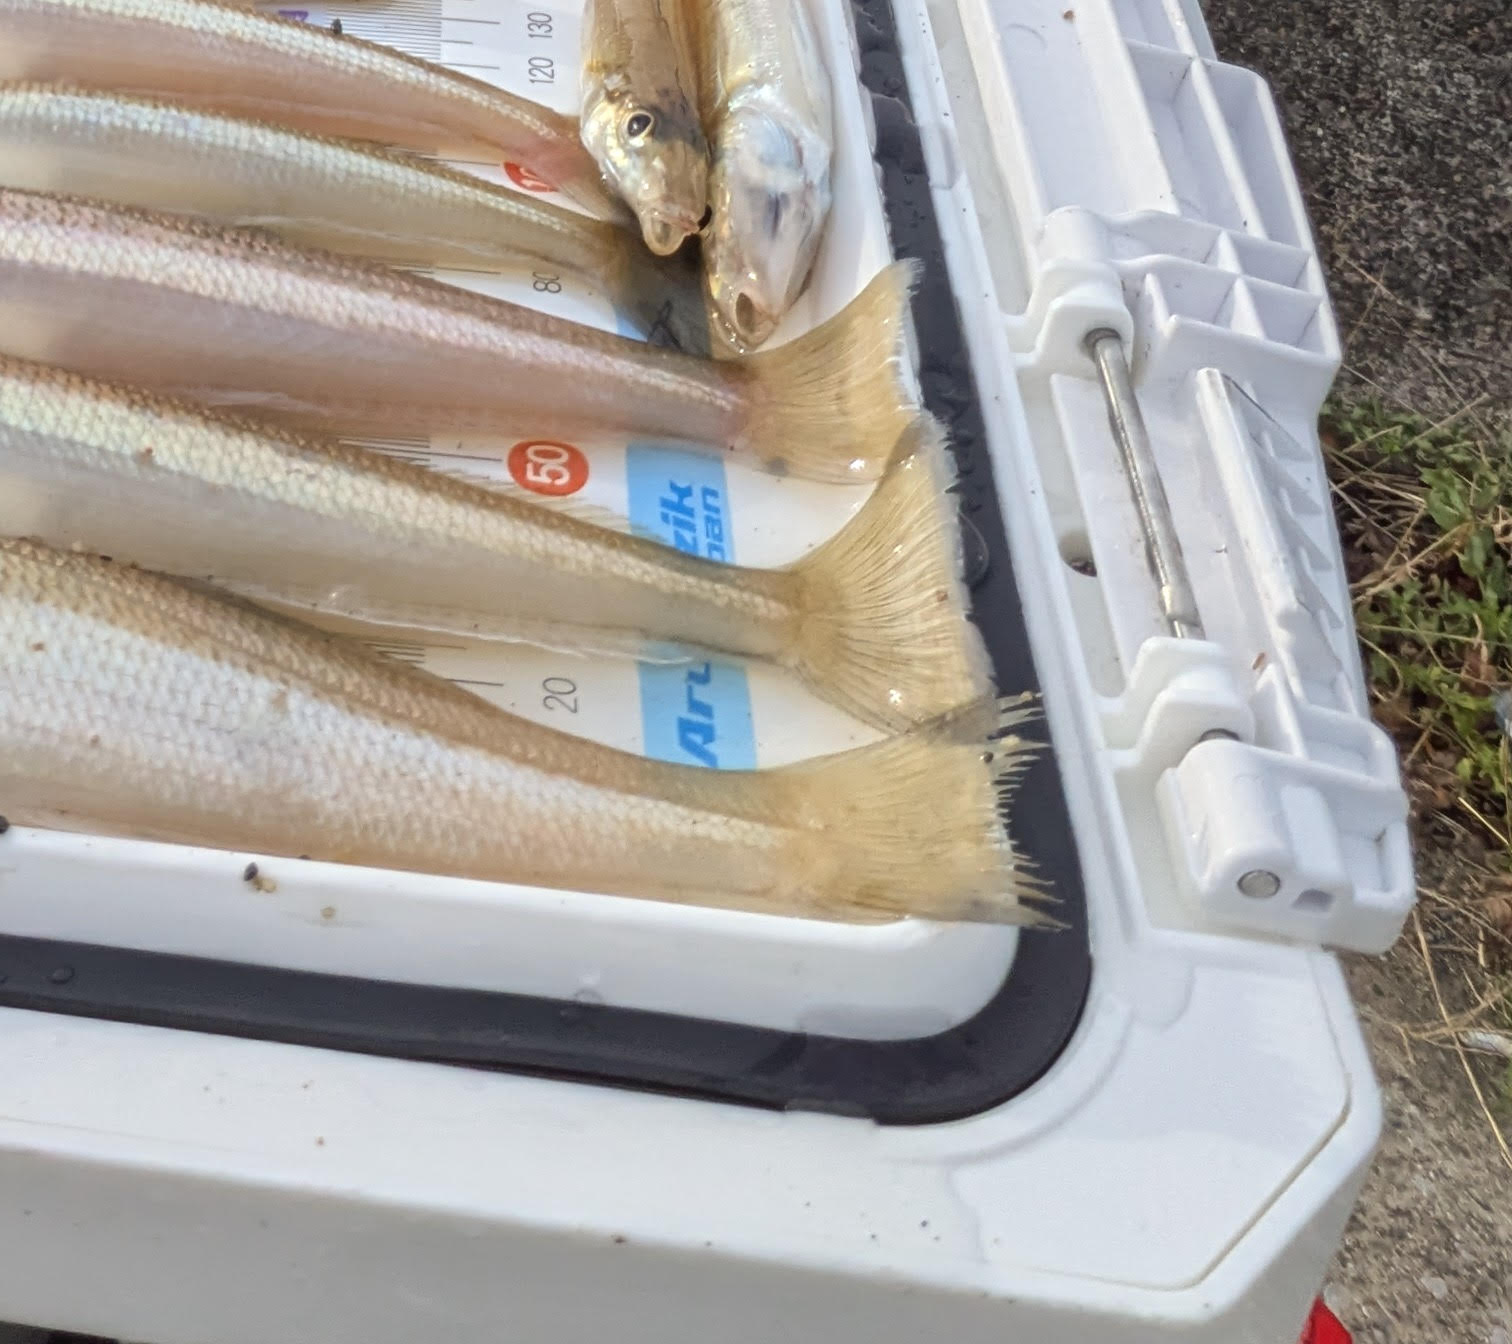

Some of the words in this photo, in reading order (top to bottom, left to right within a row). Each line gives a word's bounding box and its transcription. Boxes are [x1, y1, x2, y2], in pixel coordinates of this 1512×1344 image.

[527, 12, 553, 38] 130
[528, 56, 555, 84] 120
[525, 444, 571, 486] 50
[542, 677, 578, 714] 20
